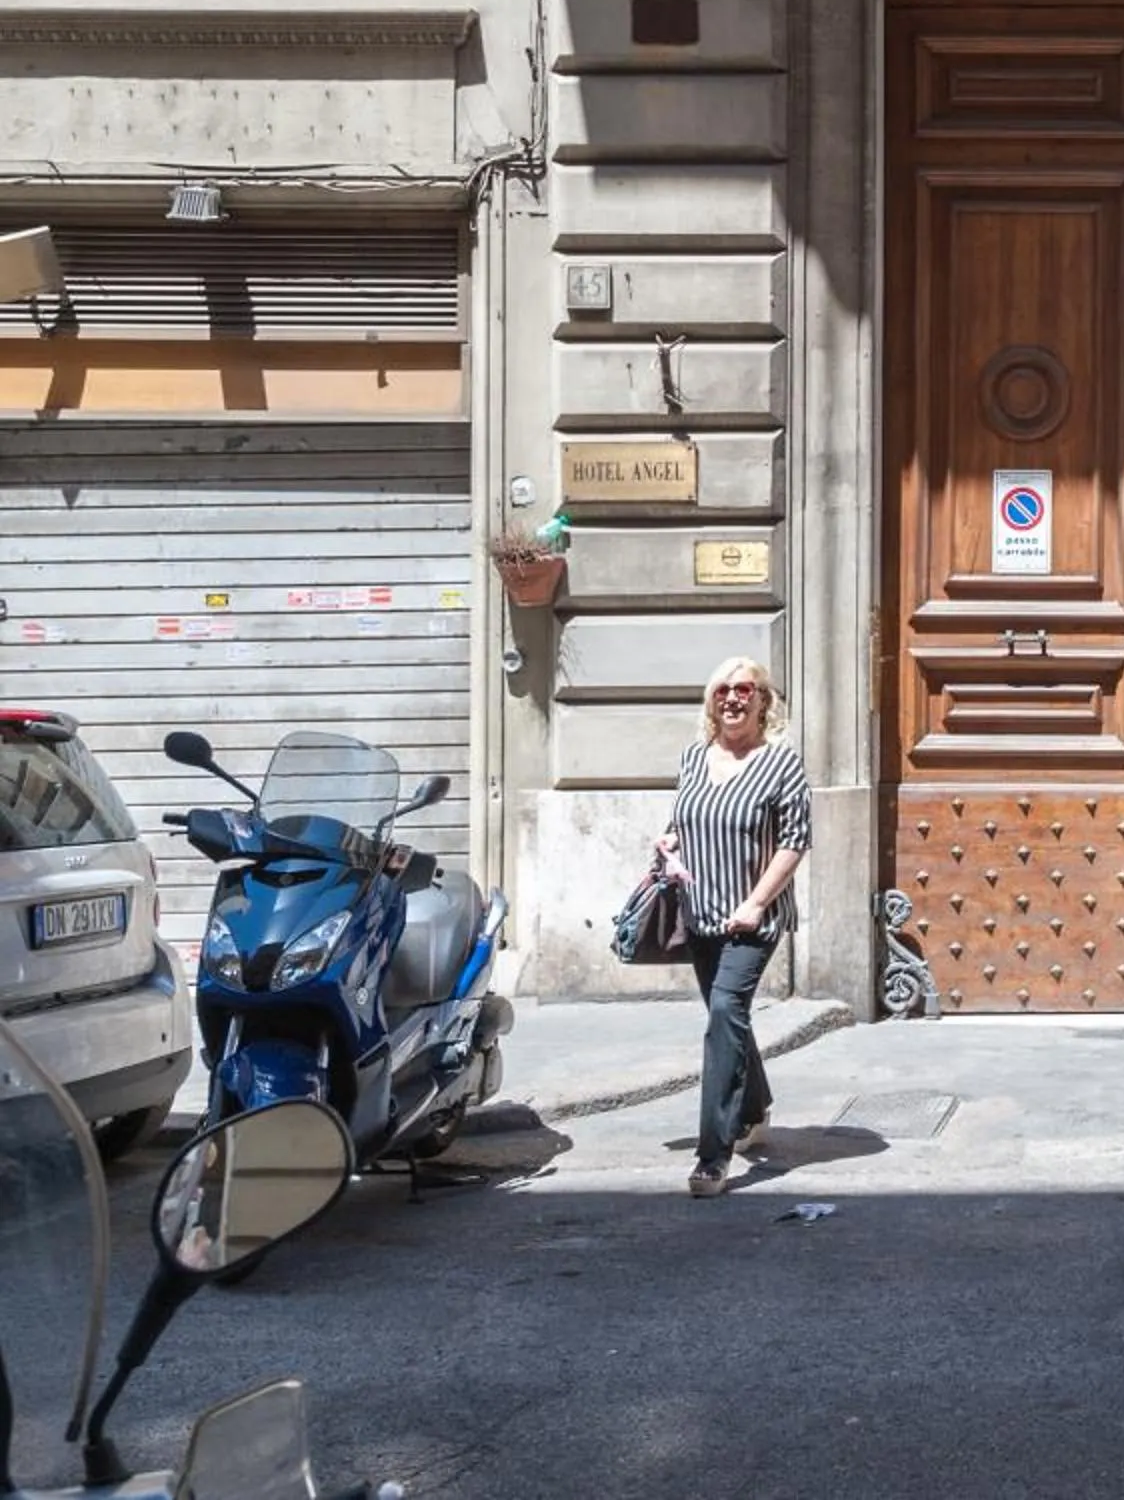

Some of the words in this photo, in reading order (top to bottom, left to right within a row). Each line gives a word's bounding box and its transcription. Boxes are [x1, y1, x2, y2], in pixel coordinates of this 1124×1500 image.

[571, 272, 602, 298] 45
[573, 461, 625, 482] HOTEL
[631, 461, 685, 482] ANGEL
